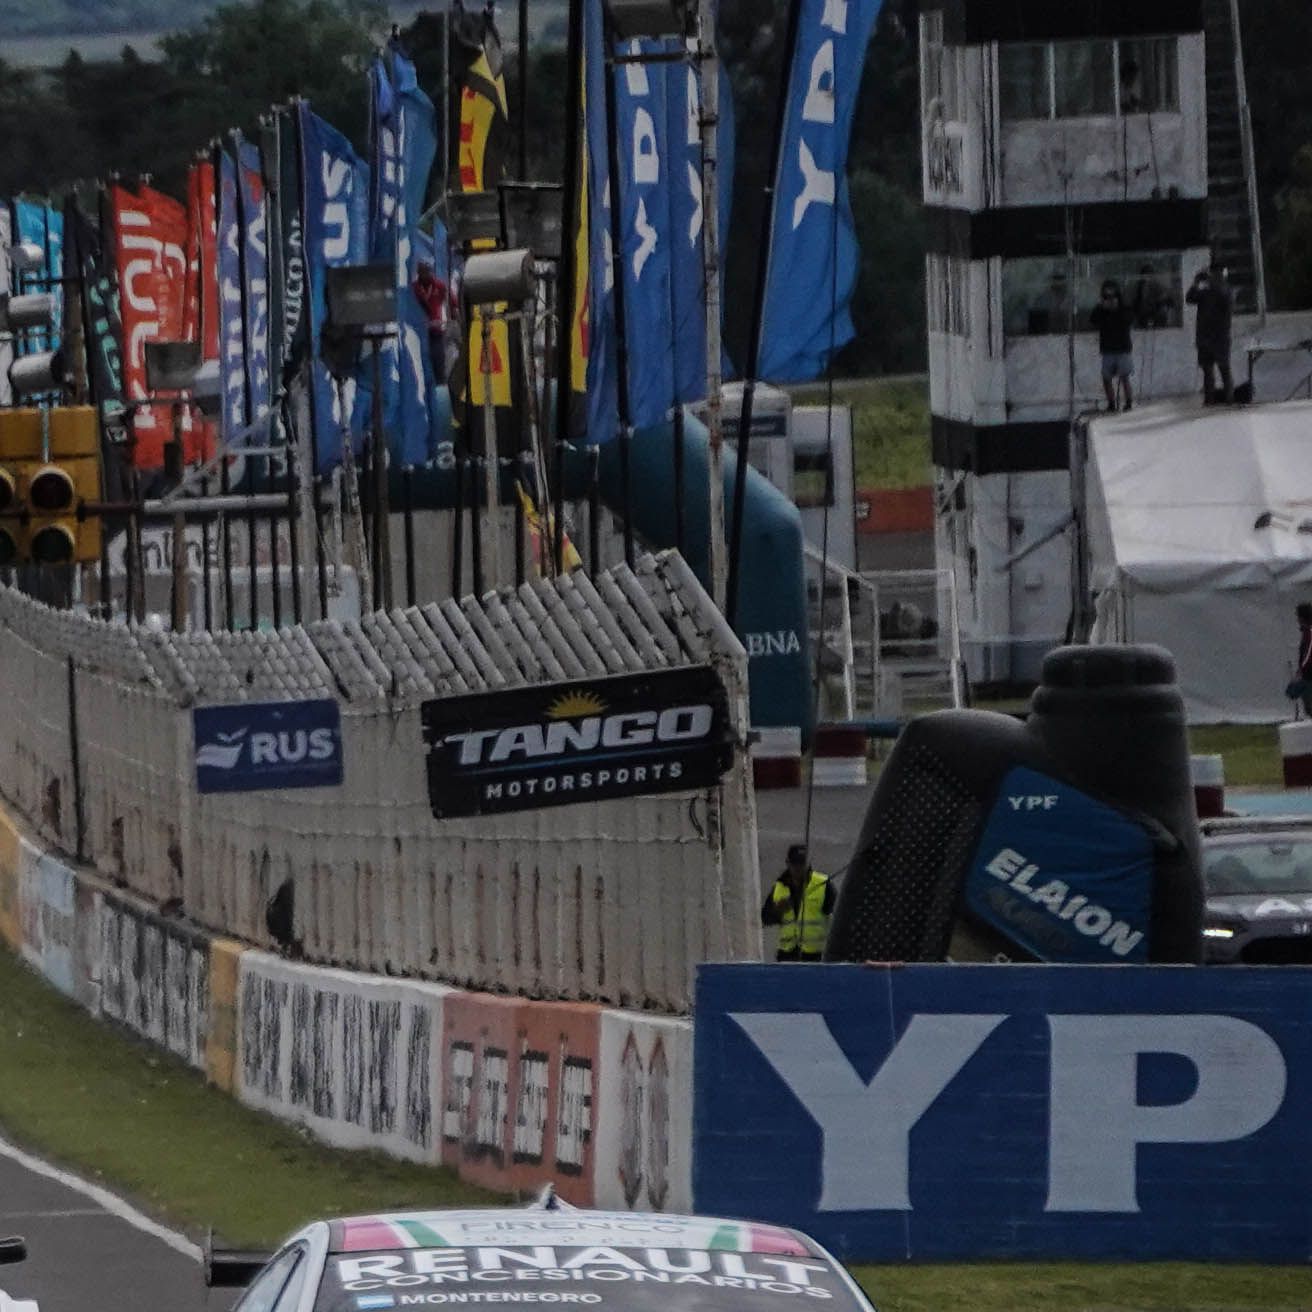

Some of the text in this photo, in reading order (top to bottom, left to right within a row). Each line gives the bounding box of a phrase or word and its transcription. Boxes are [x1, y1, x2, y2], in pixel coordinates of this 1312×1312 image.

[251, 728, 335, 765] RUS
[443, 703, 713, 765] TANGO
[485, 761, 684, 798] MOTORSPORTS
[1008, 794, 1060, 811] YPF
[984, 848, 1145, 957] ELAION
[337, 1246, 831, 1287] RENAULT
[344, 1267, 833, 1299] CONCESIONARIOS
[399, 1291, 603, 1306] MONTENEGRO
